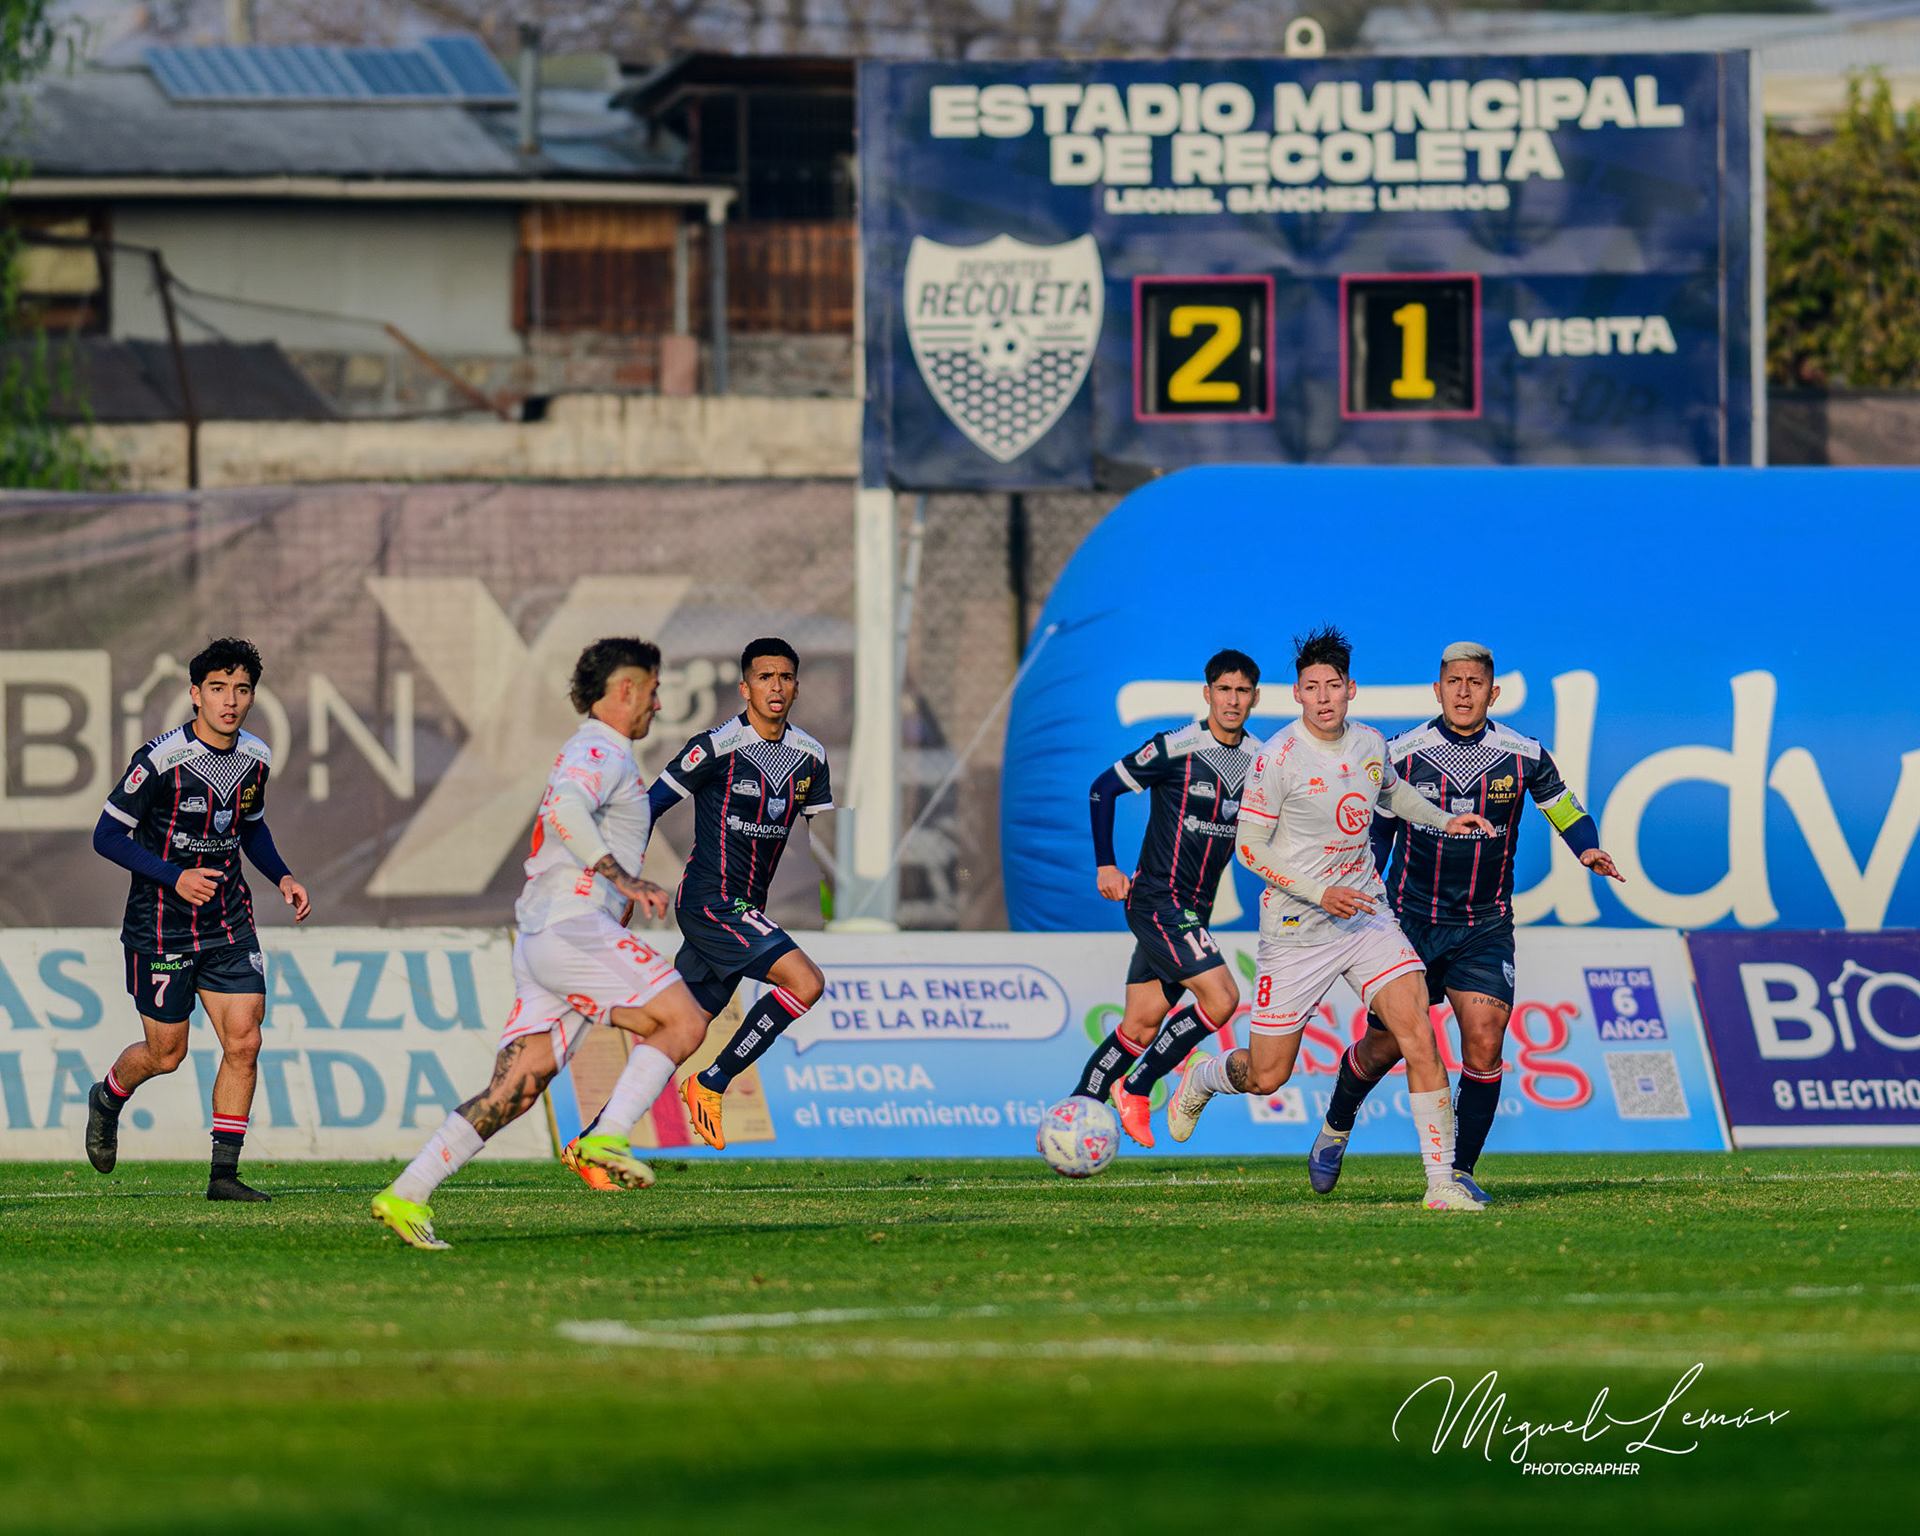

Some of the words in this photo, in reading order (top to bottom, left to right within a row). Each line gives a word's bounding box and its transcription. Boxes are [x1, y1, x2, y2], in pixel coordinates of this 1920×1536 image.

[930, 83, 1255, 138] ESTADIO
[1273, 75, 1685, 134] MUNICIPAL
[1050, 132, 1152, 186] DE
[1171, 128, 1565, 185] RECOLETA
[1104, 187, 1224, 214] LEONEL
[1226, 183, 1376, 214] SÁNCHEZ
[1378, 184, 1511, 211] LINEROS
[956, 259, 1053, 279] DEPORTES
[917, 281, 1092, 318] RECOLETA
[1390, 303, 1435, 399] 1
[1509, 315, 1677, 358] VISITA
[1167, 304, 1242, 402] 2
[1487, 792, 1517, 801] MARLEY
[1183, 926, 1220, 961] 14
[151, 973, 171, 1008] 7
[880, 979, 917, 1001] LA
[925, 974, 1049, 1001] ENERGÍA
[1257, 975, 1272, 1008] 8
[1587, 968, 1623, 988] RAÍZ
[1627, 971, 1651, 987] DE
[830, 1009, 870, 1030] DE
[877, 1009, 915, 1030] LA
[921, 1003, 1010, 1030] RAÍZ...
[1611, 987, 1638, 1018] 6
[1601, 1017, 1665, 1040] AÑOS
[783, 1063, 935, 1092] MEJORA
[1772, 1079, 1795, 1110] 8
[794, 1101, 820, 1127] el
[826, 1100, 1000, 1127] rendimiento
